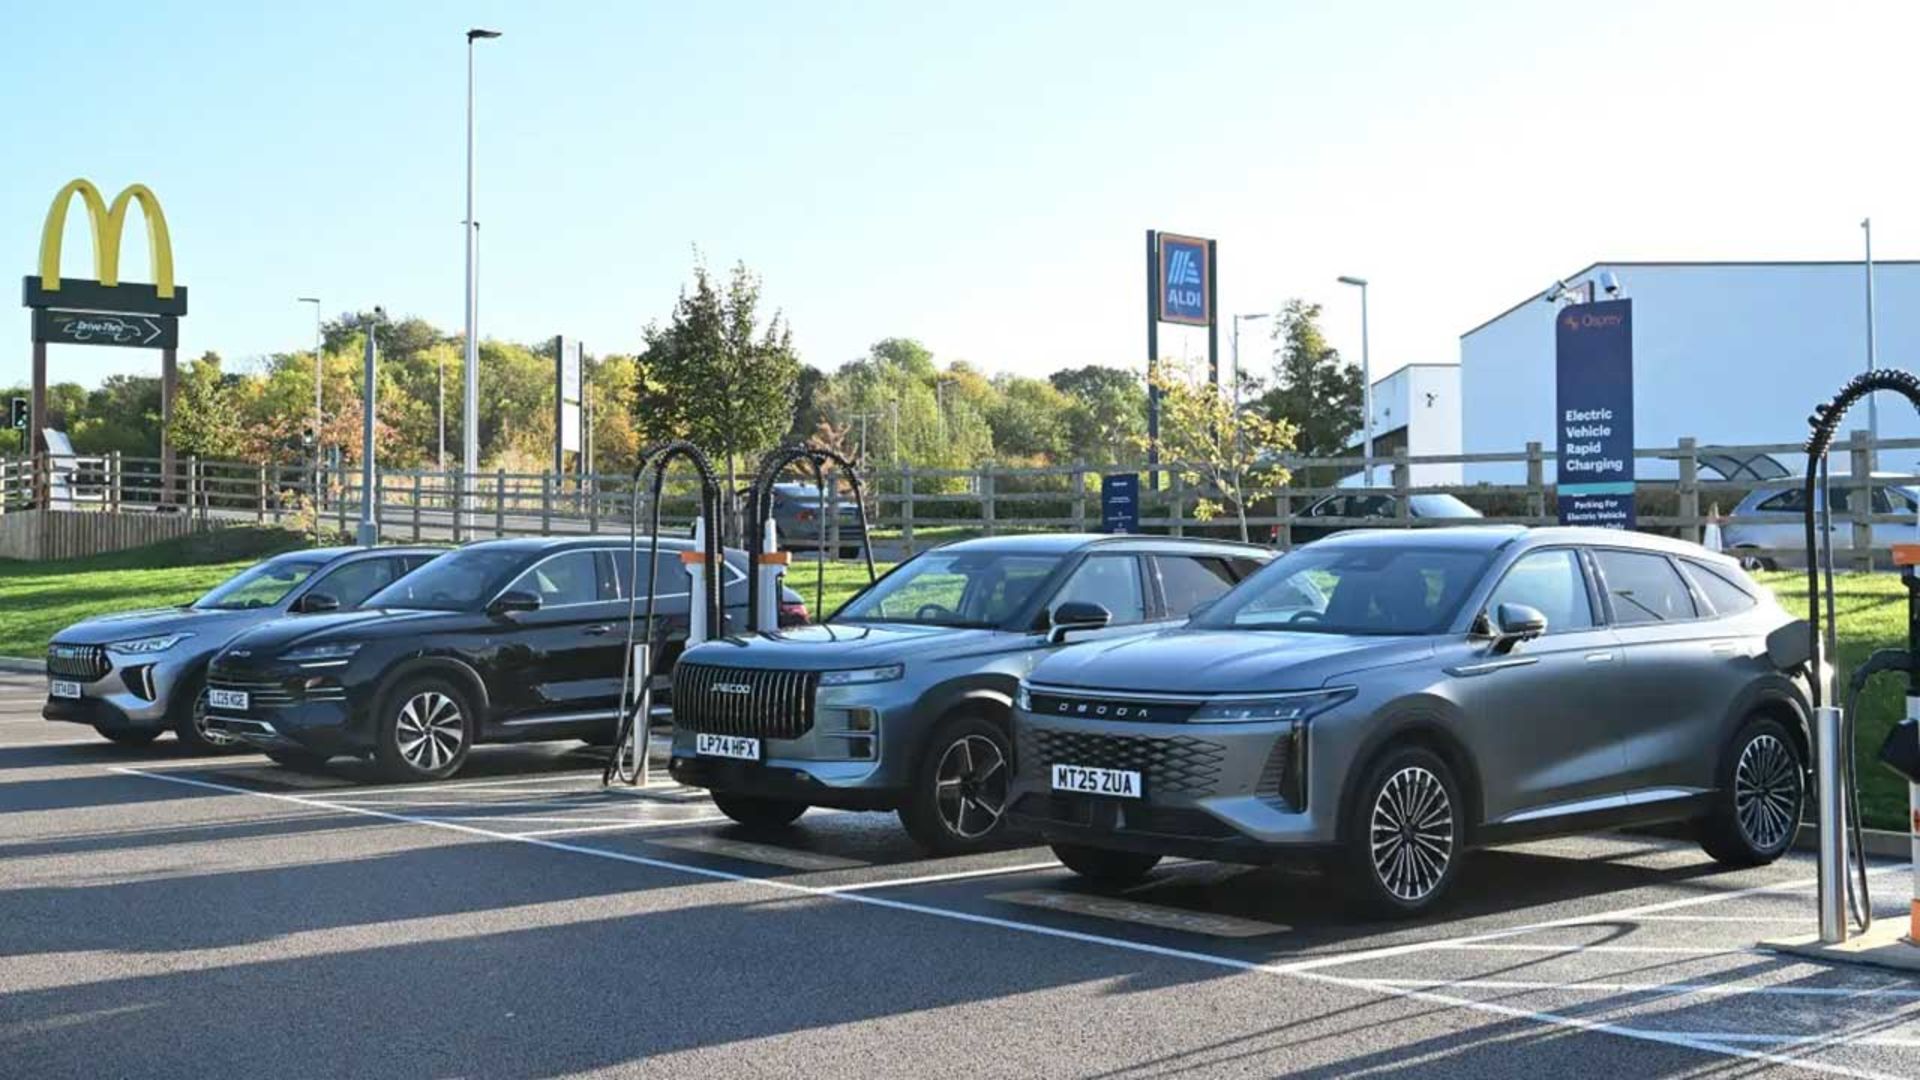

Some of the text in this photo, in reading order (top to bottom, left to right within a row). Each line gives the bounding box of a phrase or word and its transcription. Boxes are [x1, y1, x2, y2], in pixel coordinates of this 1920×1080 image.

[1168, 288, 1201, 308] ALDI
[1566, 408, 1613, 421] Electric
[1566, 425, 1611, 438] Vehicle
[1566, 441, 1602, 456] Rapid
[1566, 457, 1623, 473] Charging
[1574, 499, 1618, 510] Parking For
[1567, 510, 1627, 522] Electric Vehicle
[700, 734, 756, 757] LP74 HFX
[1058, 767, 1133, 794] MT25 ZUA
